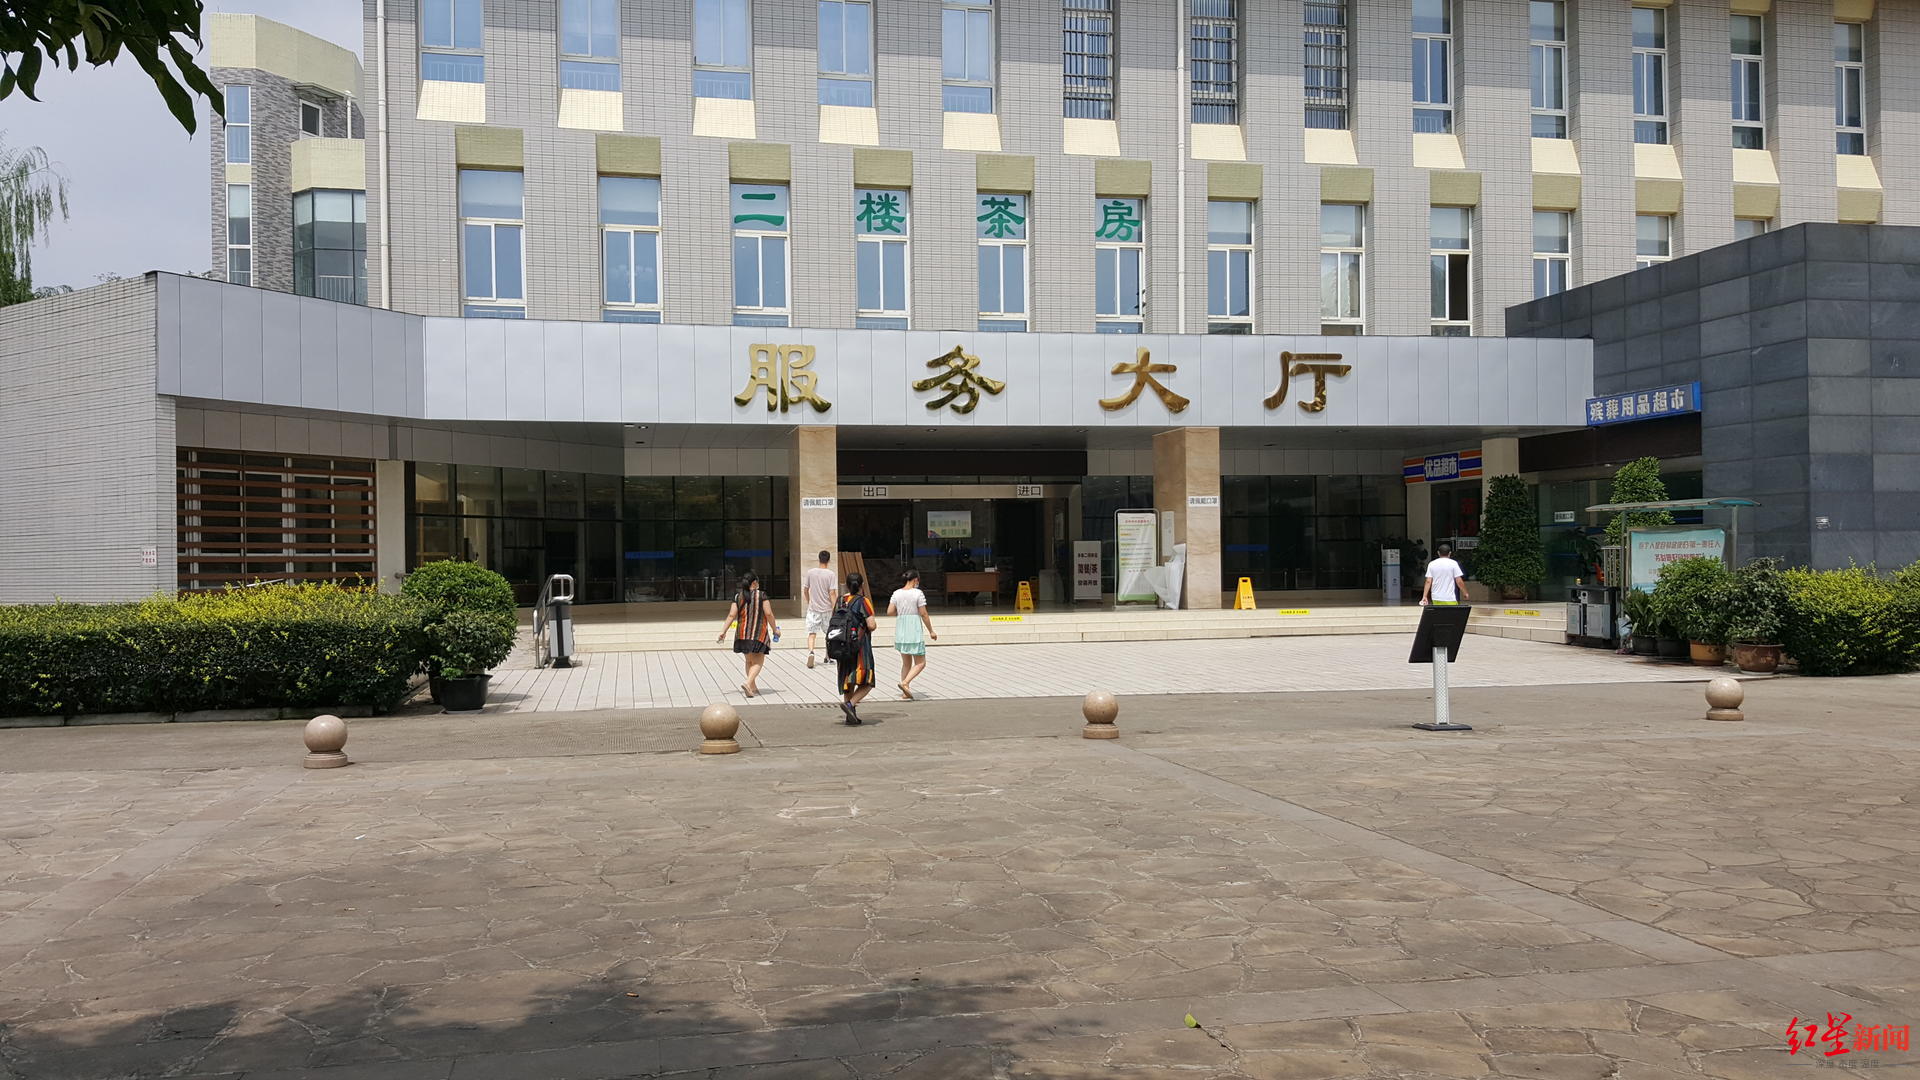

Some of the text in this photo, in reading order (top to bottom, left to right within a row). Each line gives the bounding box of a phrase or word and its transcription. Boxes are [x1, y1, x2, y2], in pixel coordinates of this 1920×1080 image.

[734, 192, 1140, 241] 二楼茶房
[734, 345, 1352, 414] 服务大厅
[1590, 388, 1685, 422] 殡葬用品超市
[1424, 457, 1457, 478] 优品超市
[863, 486, 887, 497] 出口
[1017, 486, 1041, 496] 进口
[803, 498, 834, 507] 请佩戴口罩
